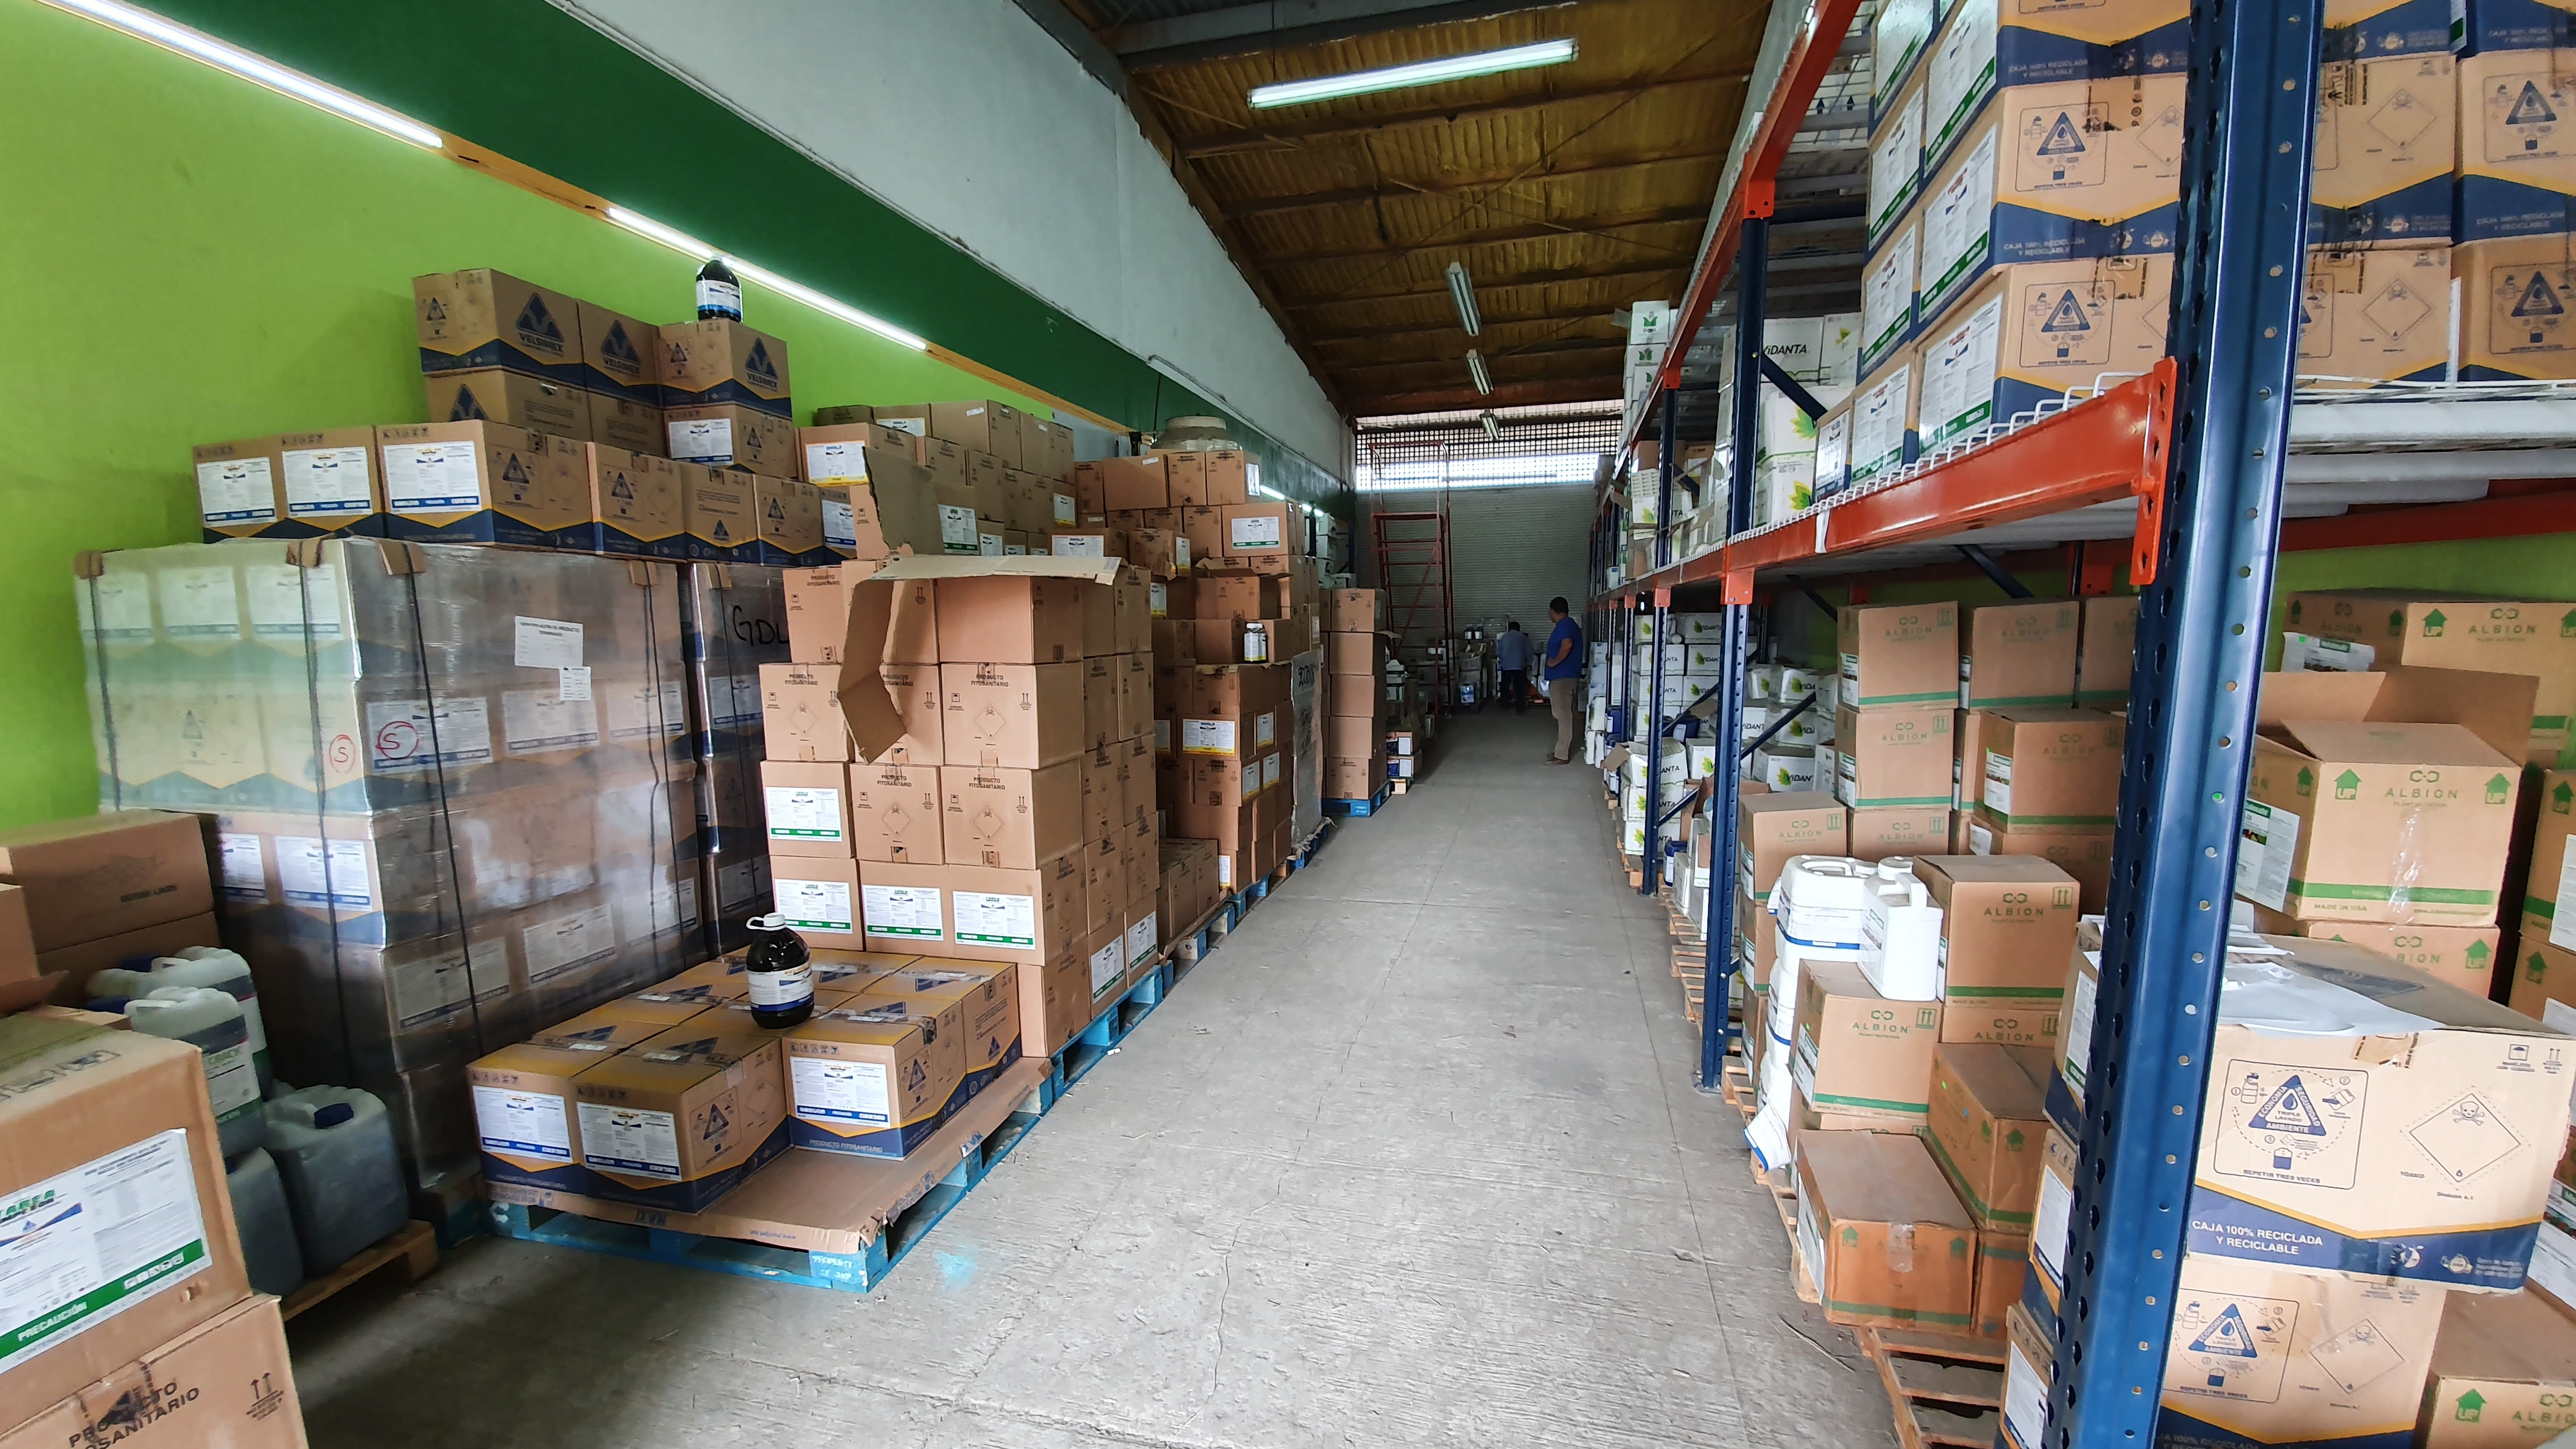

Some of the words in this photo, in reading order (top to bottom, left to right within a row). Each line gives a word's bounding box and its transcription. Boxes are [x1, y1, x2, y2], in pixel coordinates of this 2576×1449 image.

[519, 332, 564, 353] VELSIMEX
[1884, 626, 1933, 637] ALBION
[2468, 624, 2537, 635] ALBION
[1881, 732, 1928, 741] ALBION
[2042, 746, 2096, 755] ALBION
[1661, 765, 1680, 774] ANTA
[2384, 788, 2459, 799] ALBION
[1778, 830, 1823, 838] ALBION
[1983, 907, 2044, 916] ALBION
[2397, 952, 2440, 964] BION
[1852, 1021, 1909, 1034] ALBION
[1974, 1031, 2034, 1041] ALBION
[2257, 1086, 2289, 1119] ECONOMIA
[2294, 1086, 2321, 1128] SEGURIDAD
[2265, 1121, 2310, 1134] AMBIENTE
[809, 1138, 840, 1148] PRODUCTO
[840, 1142, 883, 1153] FITOSANITARIO
[2191, 1220, 2224, 1234] CAJA
[2225, 1225, 2255, 1238] 100%
[2257, 1228, 2323, 1247] RECICLADA
[2226, 1236, 2299, 1254] RECICLABLE
[18, 1301, 87, 1342] PRECAUCIÓN
[68, 1381, 178, 1448] PROCTO
[2512, 1410, 2575, 1424] ALBIO
